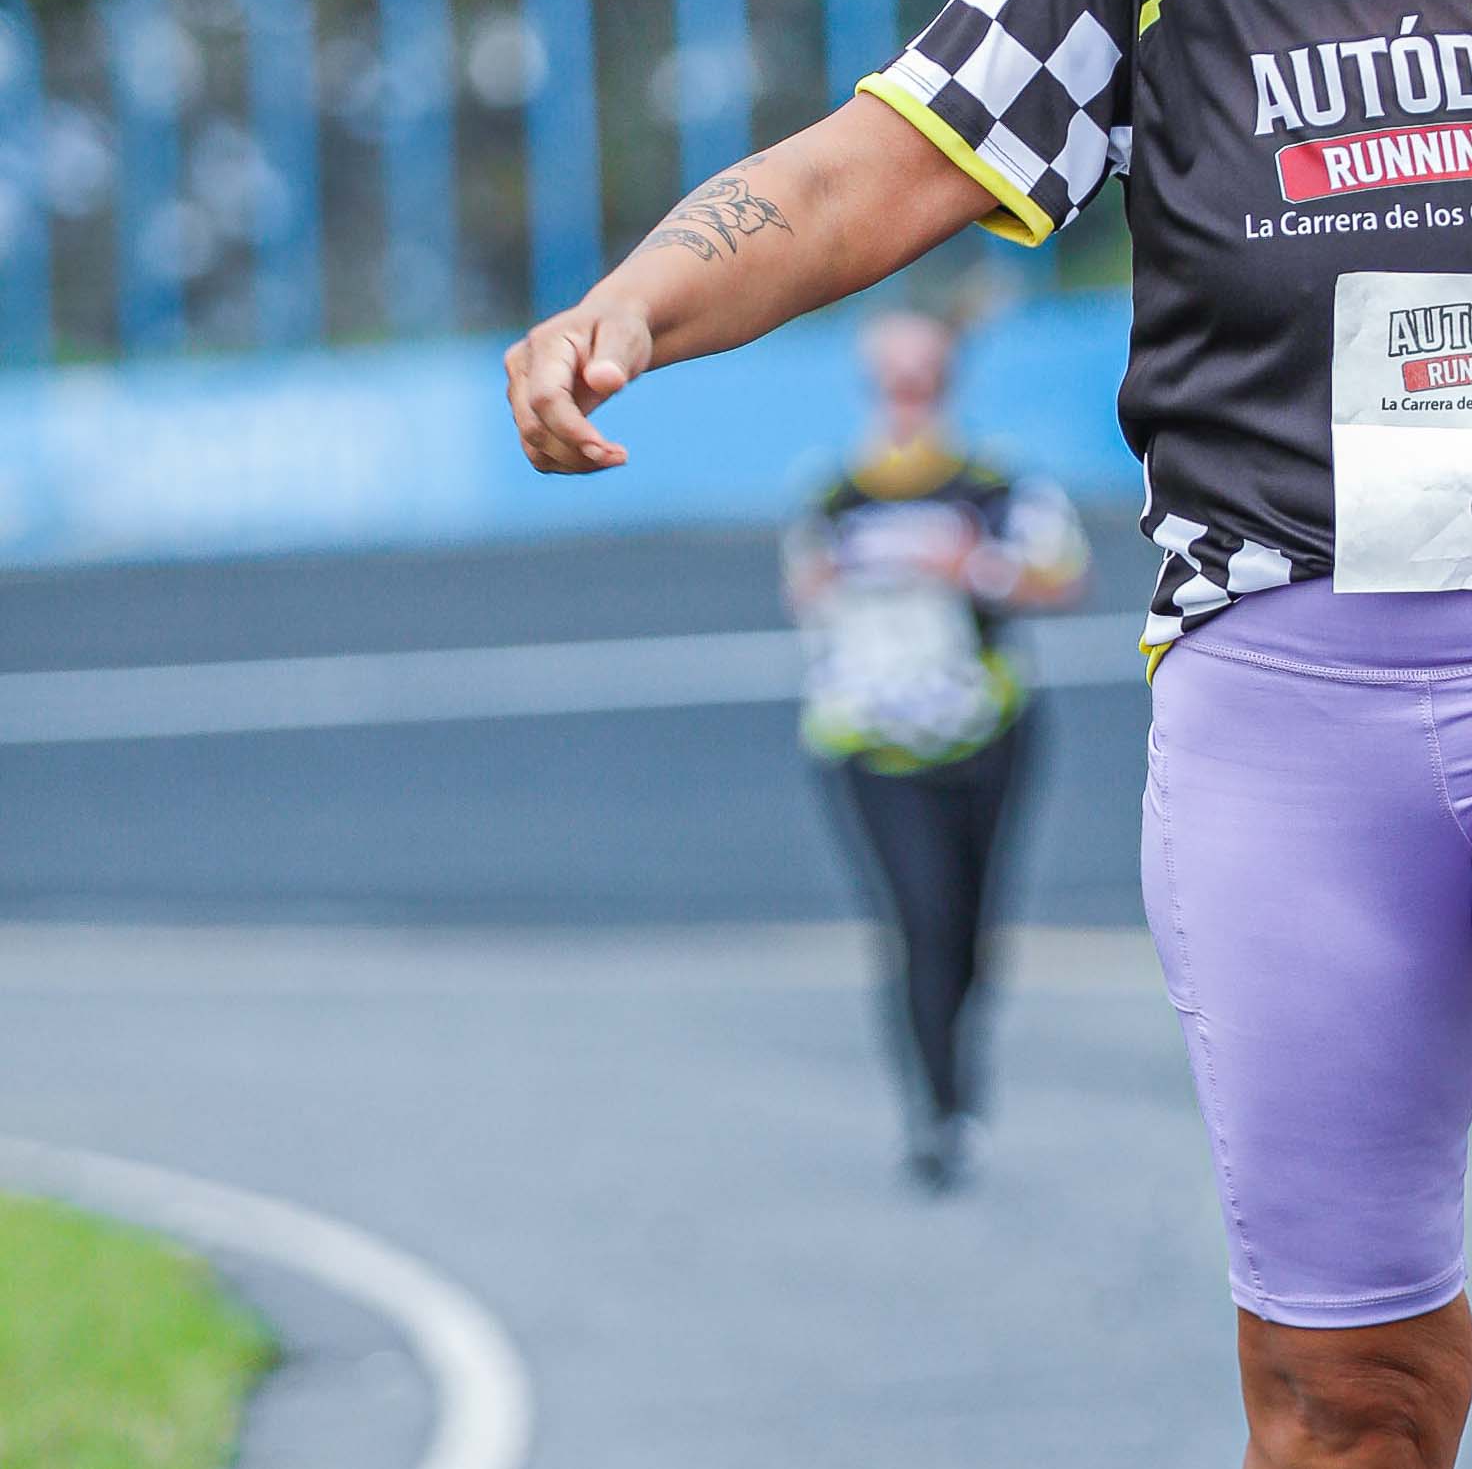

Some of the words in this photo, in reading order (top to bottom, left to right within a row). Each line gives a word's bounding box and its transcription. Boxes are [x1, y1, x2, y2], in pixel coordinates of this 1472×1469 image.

[1245, 213, 1273, 239] La
[1280, 211, 1378, 236] Carrera
[1385, 204, 1420, 229] de
[1426, 202, 1464, 227] los
[1381, 397, 1398, 411] La
[1401, 397, 1454, 412] Carrera
